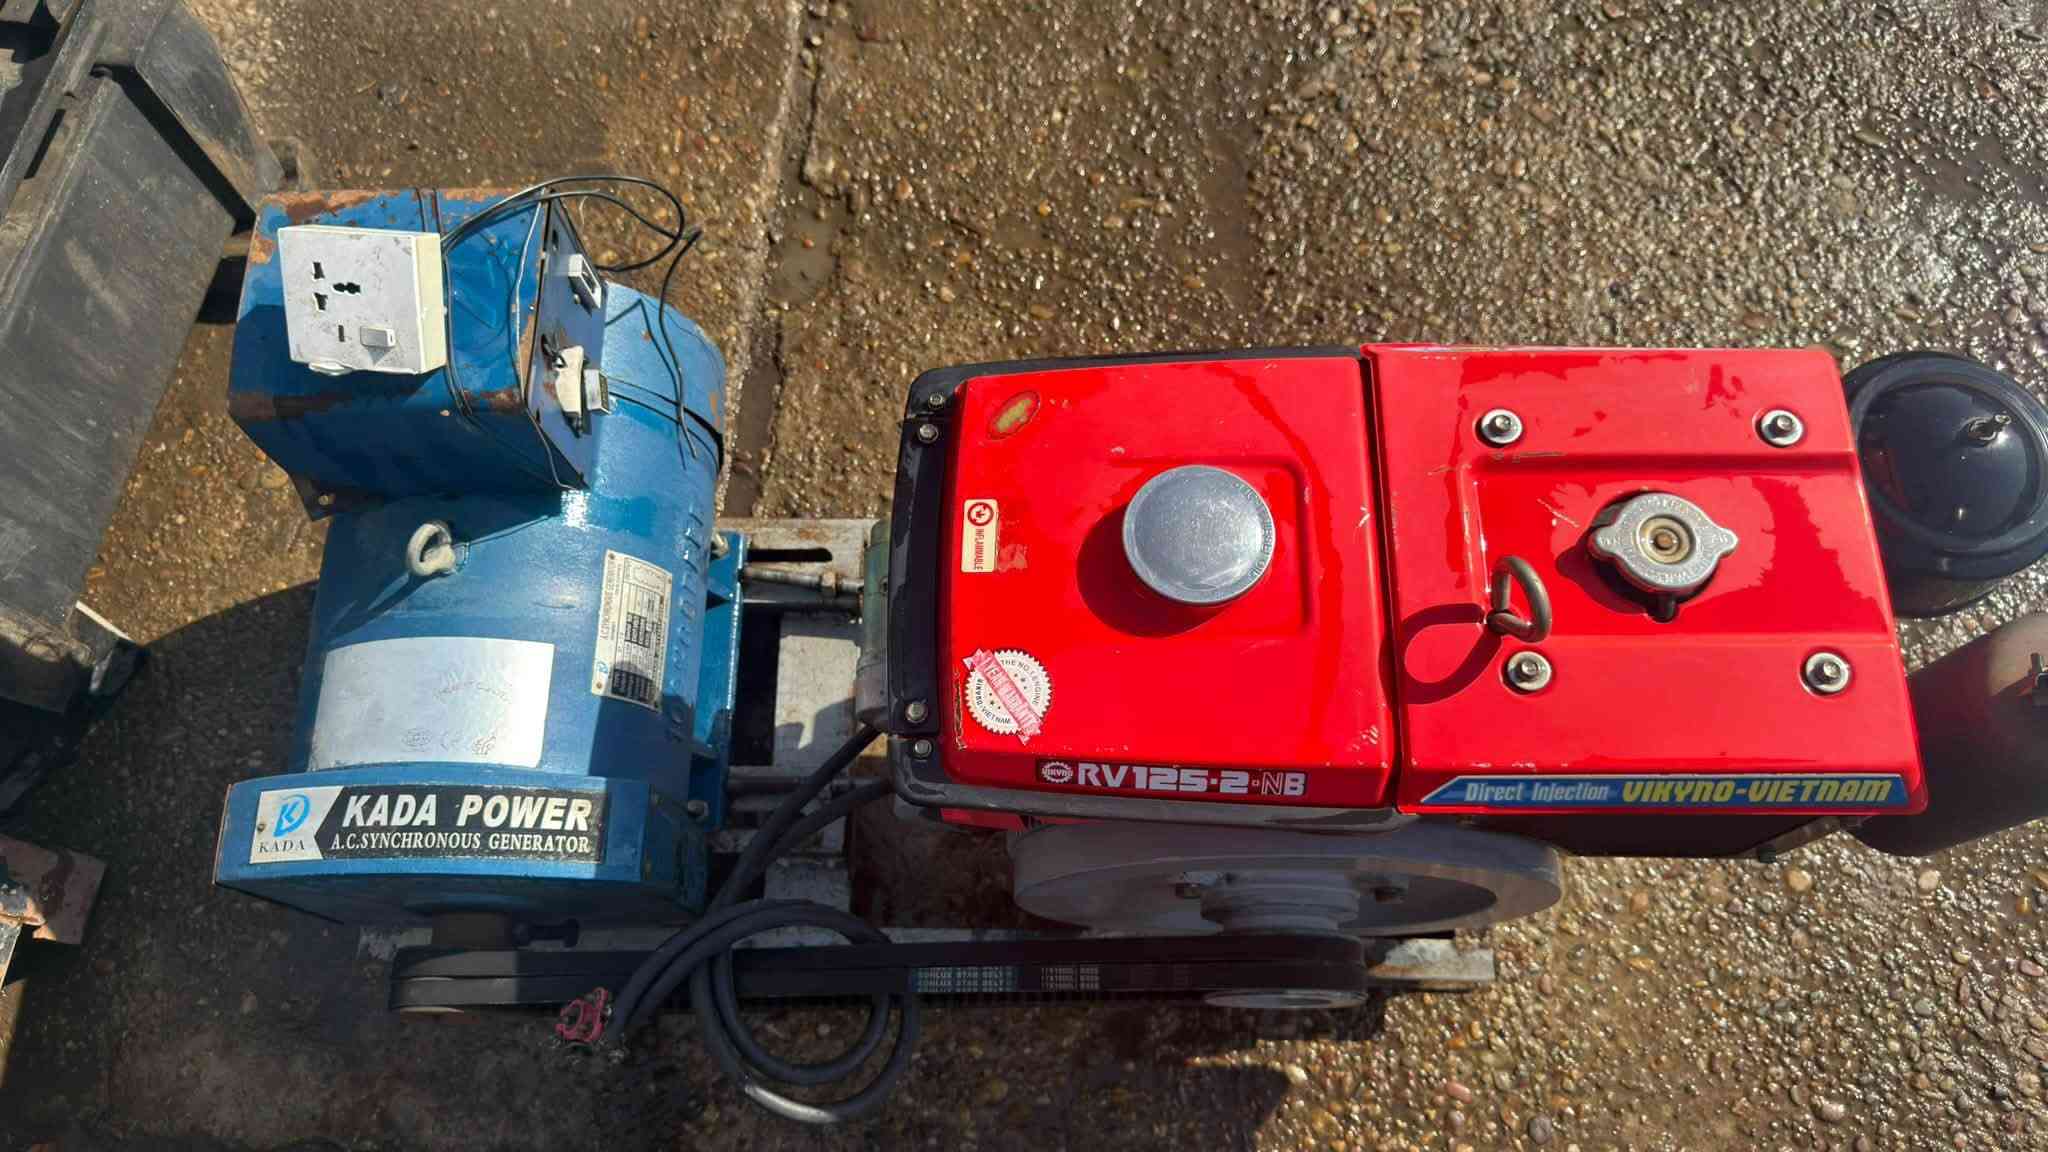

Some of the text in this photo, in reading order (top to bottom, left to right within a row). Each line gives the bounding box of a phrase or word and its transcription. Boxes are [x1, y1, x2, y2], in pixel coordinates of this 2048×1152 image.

[974, 528, 985, 570] INFLAMMABLE
[1464, 781, 1525, 802] Direct
[1531, 782, 1610, 802] Injection
[342, 793, 592, 832] KADA POWER
[257, 839, 305, 853] KADA
[330, 831, 591, 853] A.C.SYNCHRONOUS GENERATOR
